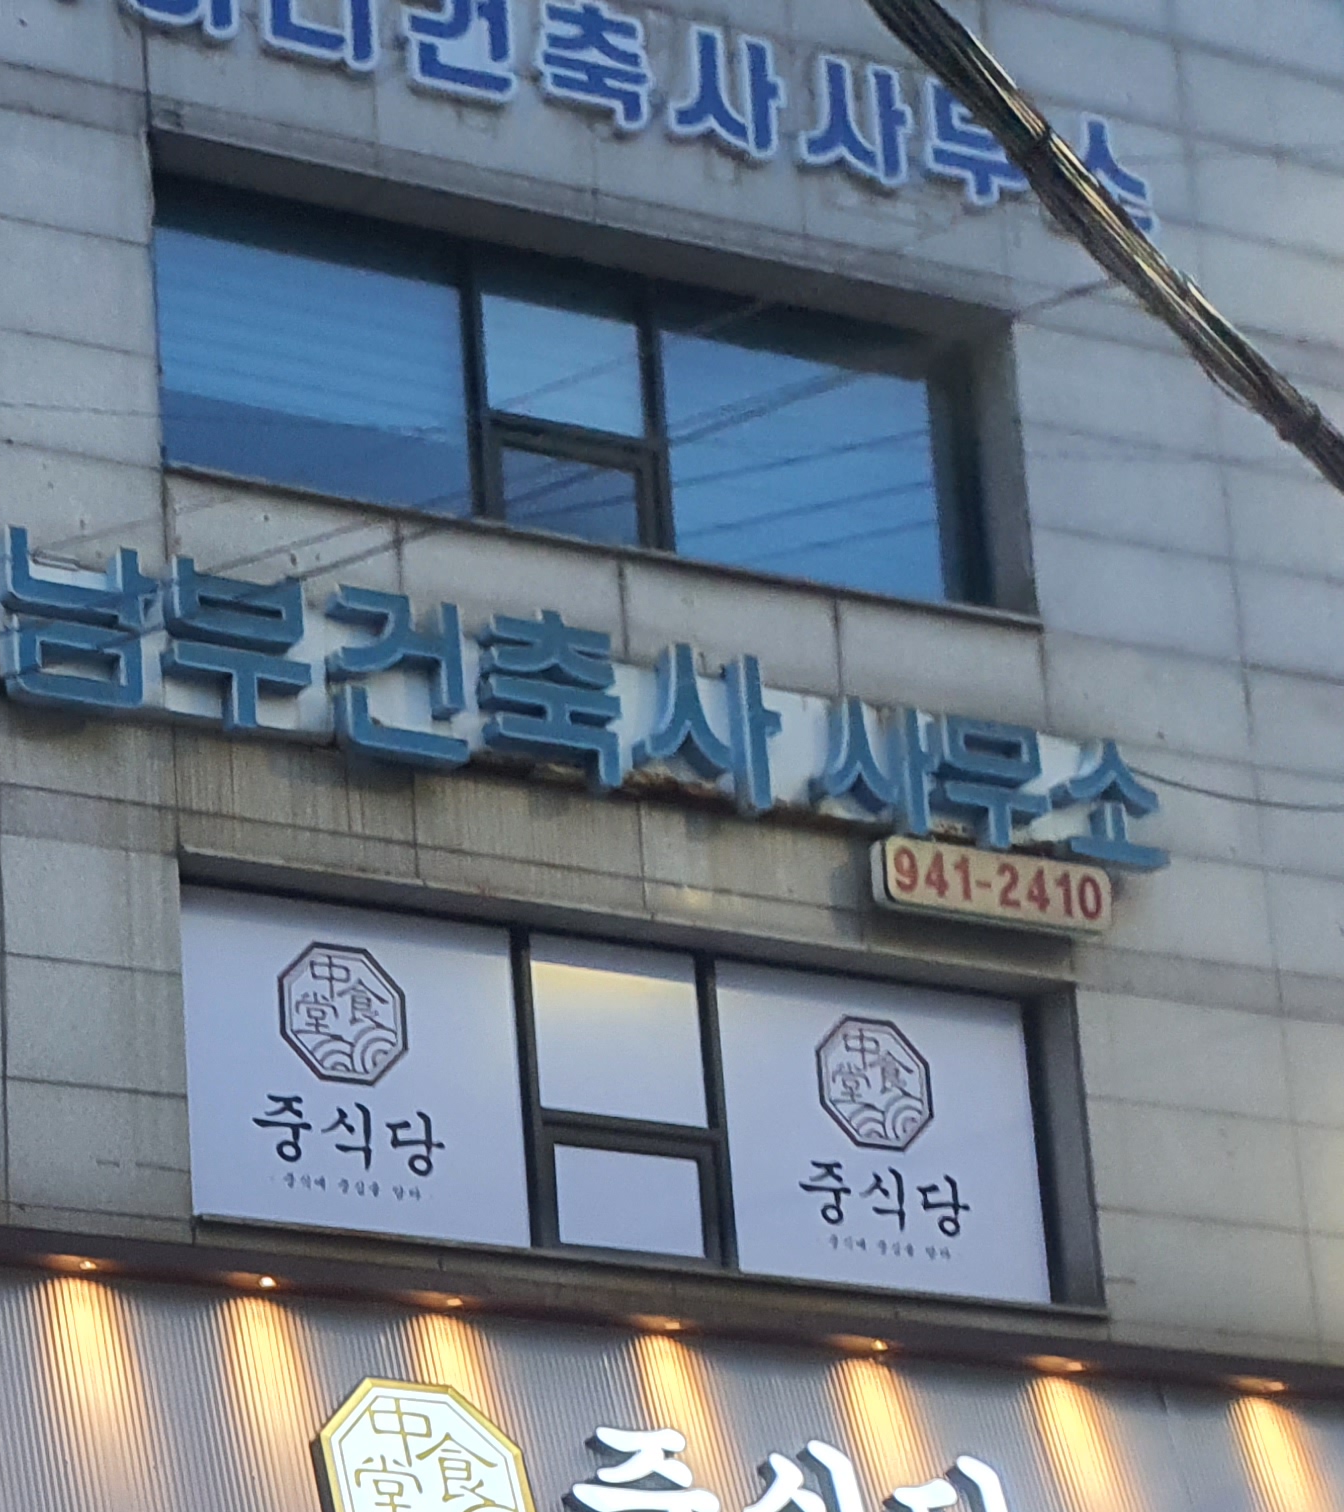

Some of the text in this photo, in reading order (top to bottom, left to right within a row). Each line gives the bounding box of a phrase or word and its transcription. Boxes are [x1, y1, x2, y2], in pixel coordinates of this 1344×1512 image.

[812, 694, 1170, 872] 사무소
[890, 843, 1104, 924] 941-2410
[252, 1092, 446, 1178] 중식당
[798, 1158, 972, 1240] 중식당
